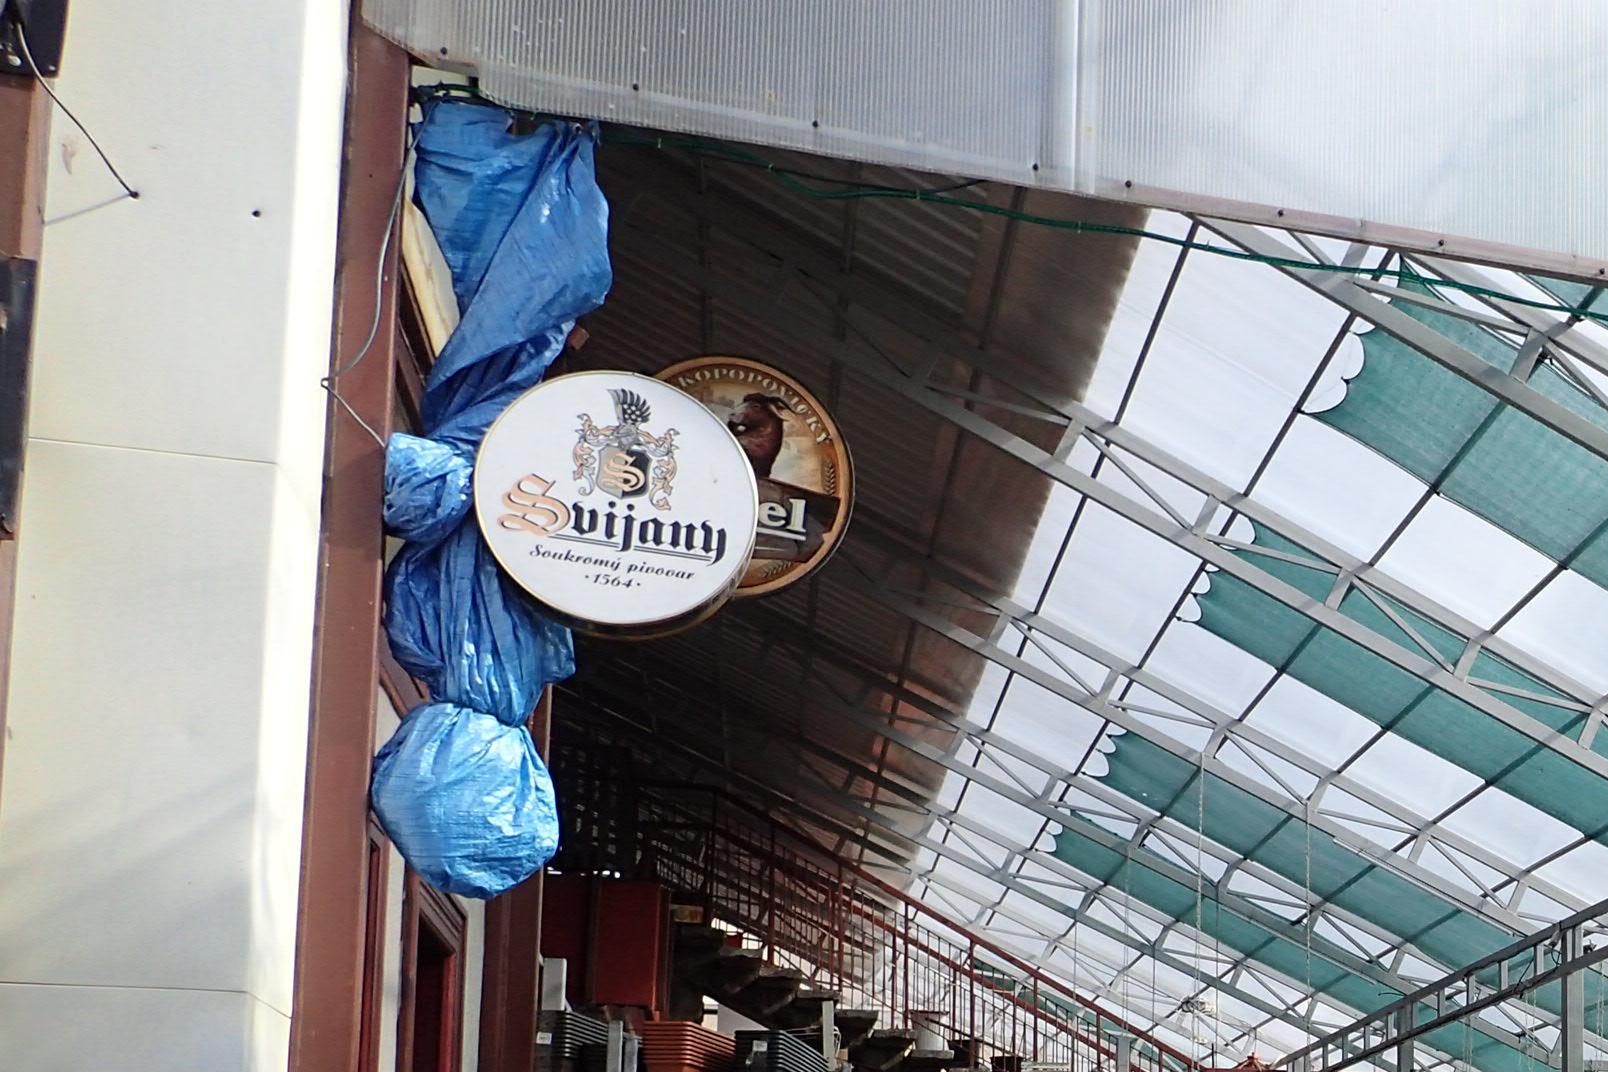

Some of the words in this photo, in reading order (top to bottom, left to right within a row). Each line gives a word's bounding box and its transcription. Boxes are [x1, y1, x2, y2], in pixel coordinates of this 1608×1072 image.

[602, 451, 646, 493] S
[497, 472, 728, 567] Svijany
[529, 543, 623, 572] Soukromý
[626, 560, 695, 580] pivovar
